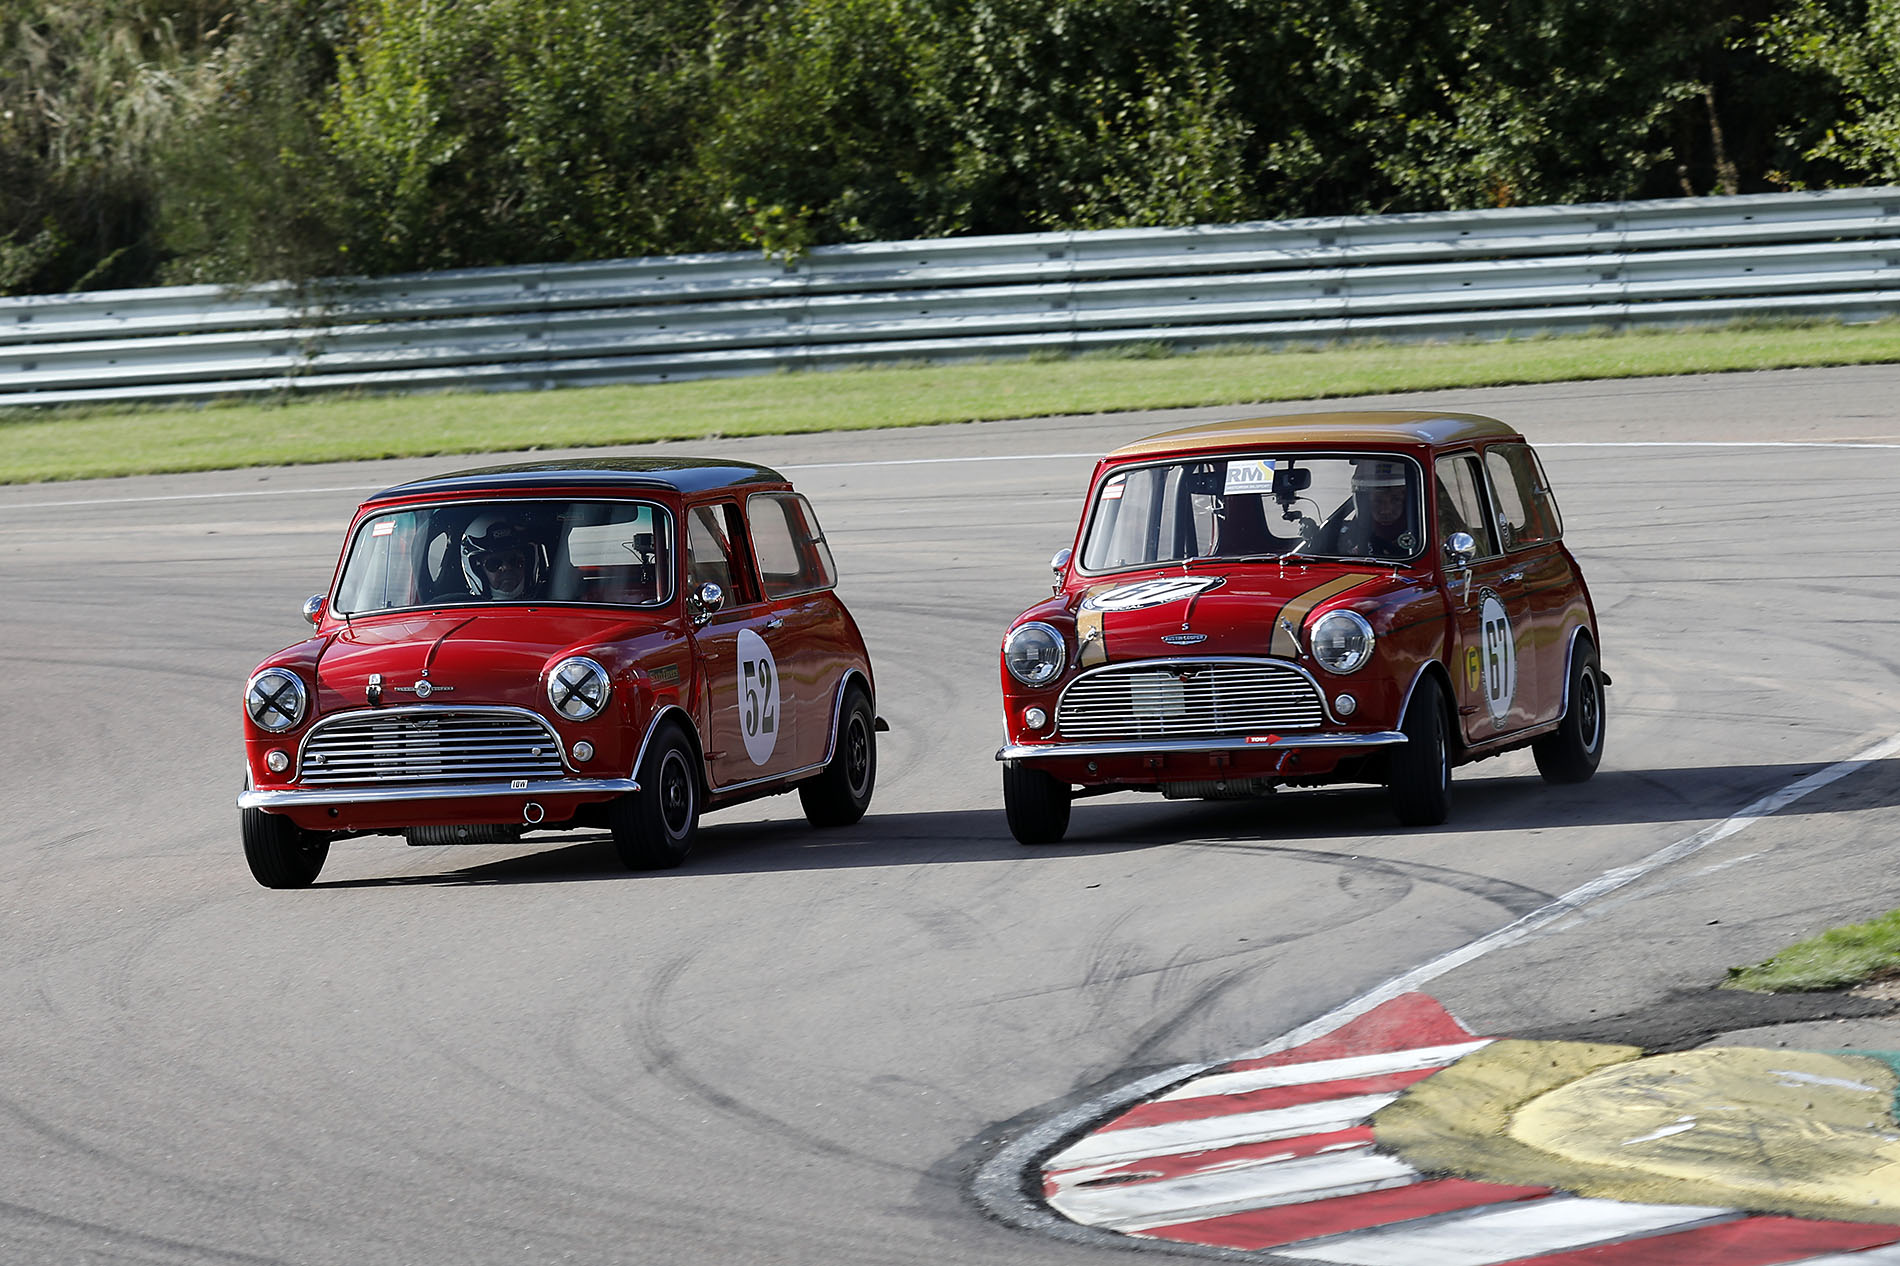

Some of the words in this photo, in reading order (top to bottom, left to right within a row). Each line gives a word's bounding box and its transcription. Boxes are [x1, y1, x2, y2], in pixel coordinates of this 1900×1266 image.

[1227, 467, 1263, 482] RM
[1181, 622, 1190, 631] S
[1469, 650, 1477, 689] F
[1485, 617, 1508, 701] 67
[421, 669, 429, 677] S
[743, 658, 774, 737] 52
